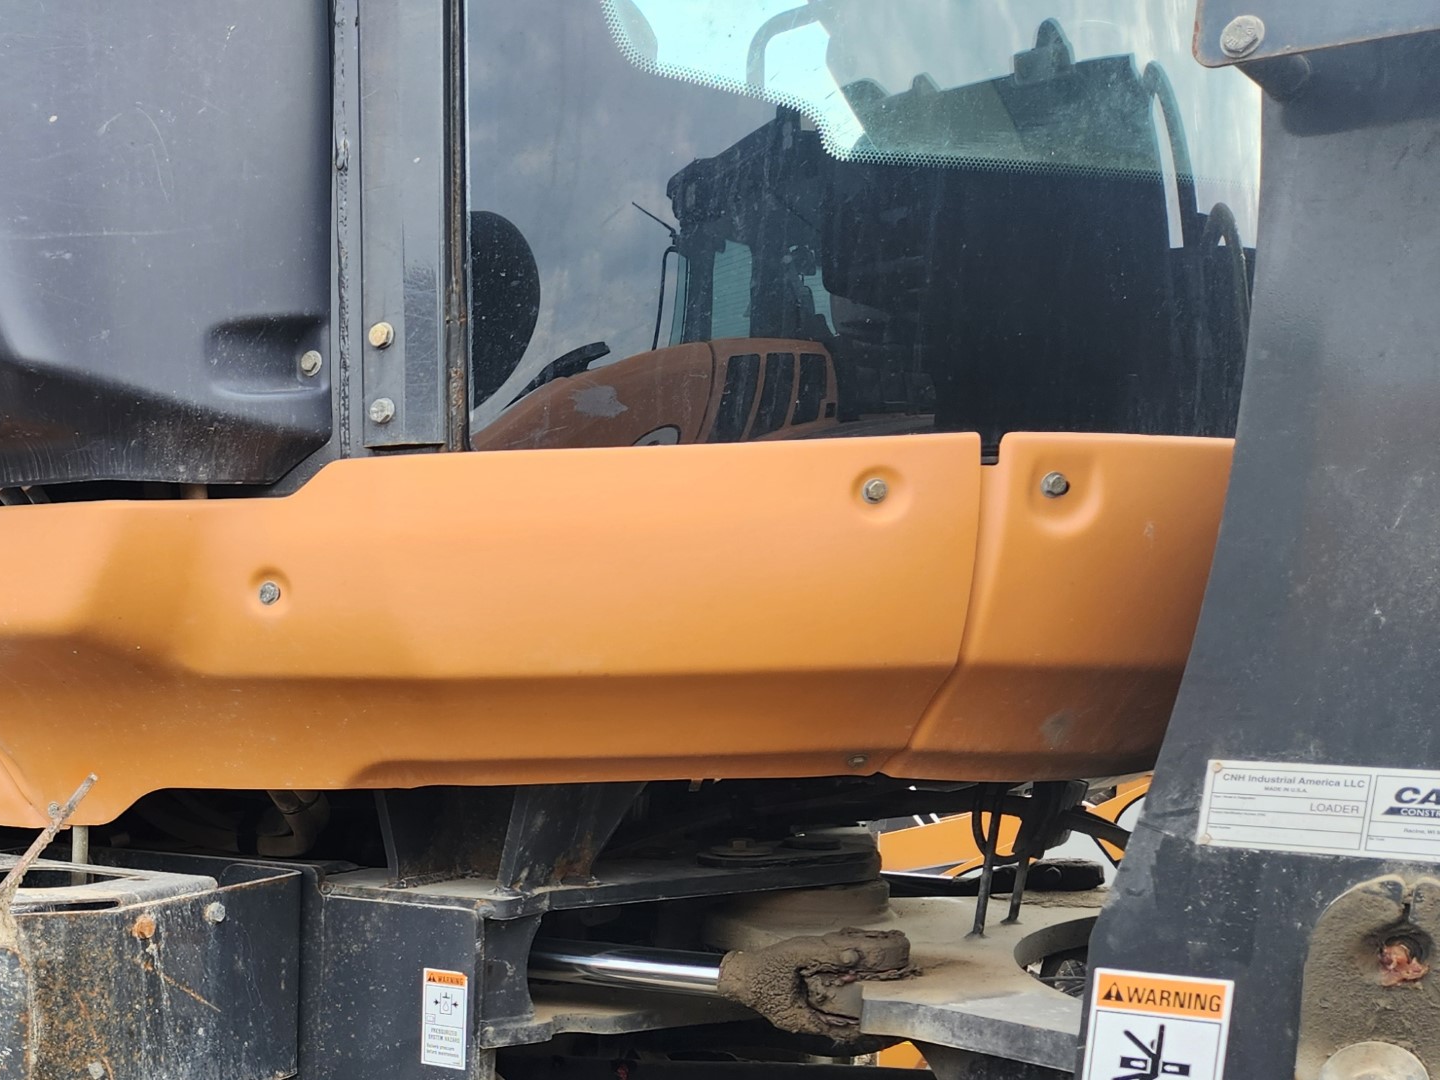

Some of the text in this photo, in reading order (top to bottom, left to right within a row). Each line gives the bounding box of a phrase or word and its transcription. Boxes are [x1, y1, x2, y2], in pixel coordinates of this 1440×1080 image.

[1222, 773, 1366, 788] CNH Industrial America LLC
[1309, 803, 1360, 815] LOADER
[437, 975, 464, 986] WARNING
[1126, 986, 1222, 1013] WARNING
